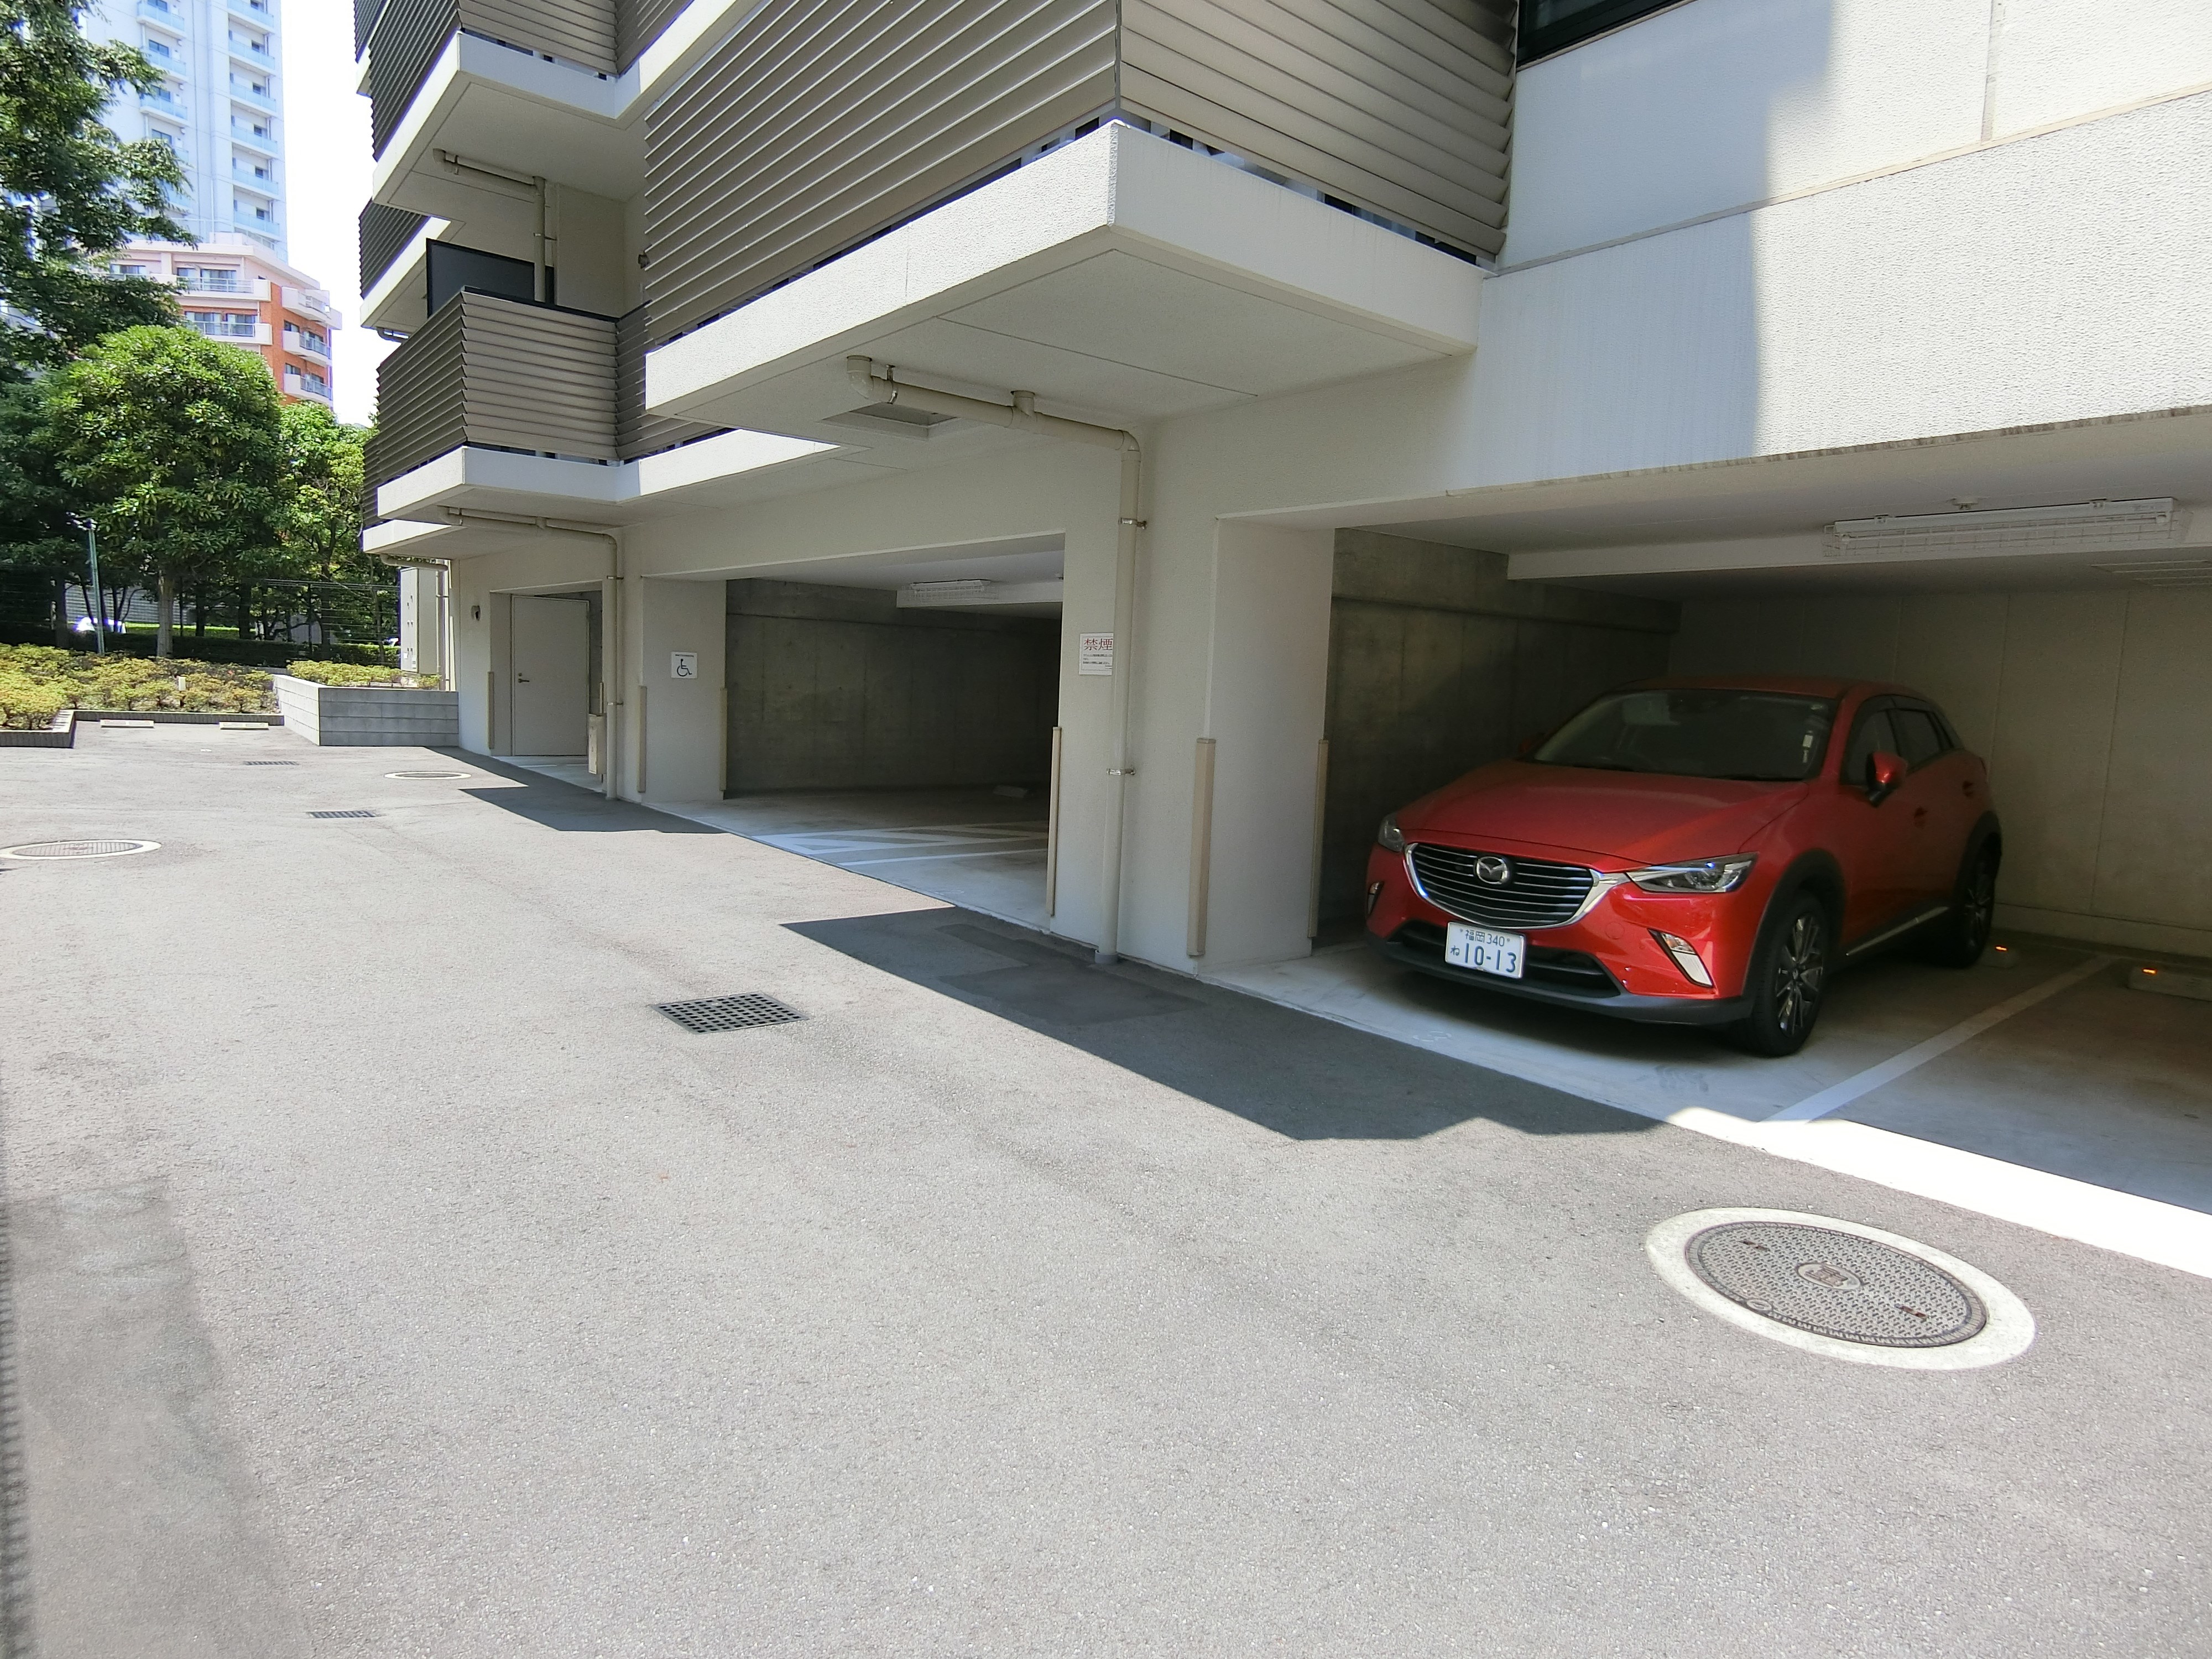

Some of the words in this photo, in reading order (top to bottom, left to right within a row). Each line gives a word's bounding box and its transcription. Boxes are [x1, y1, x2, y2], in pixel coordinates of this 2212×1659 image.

[1084, 638, 1114, 651] 禁煙
[1465, 929, 1485, 942] 福岡
[1486, 933, 1505, 947] 340
[1450, 945, 1460, 956] ね
[1464, 943, 1517, 973] 10-13
